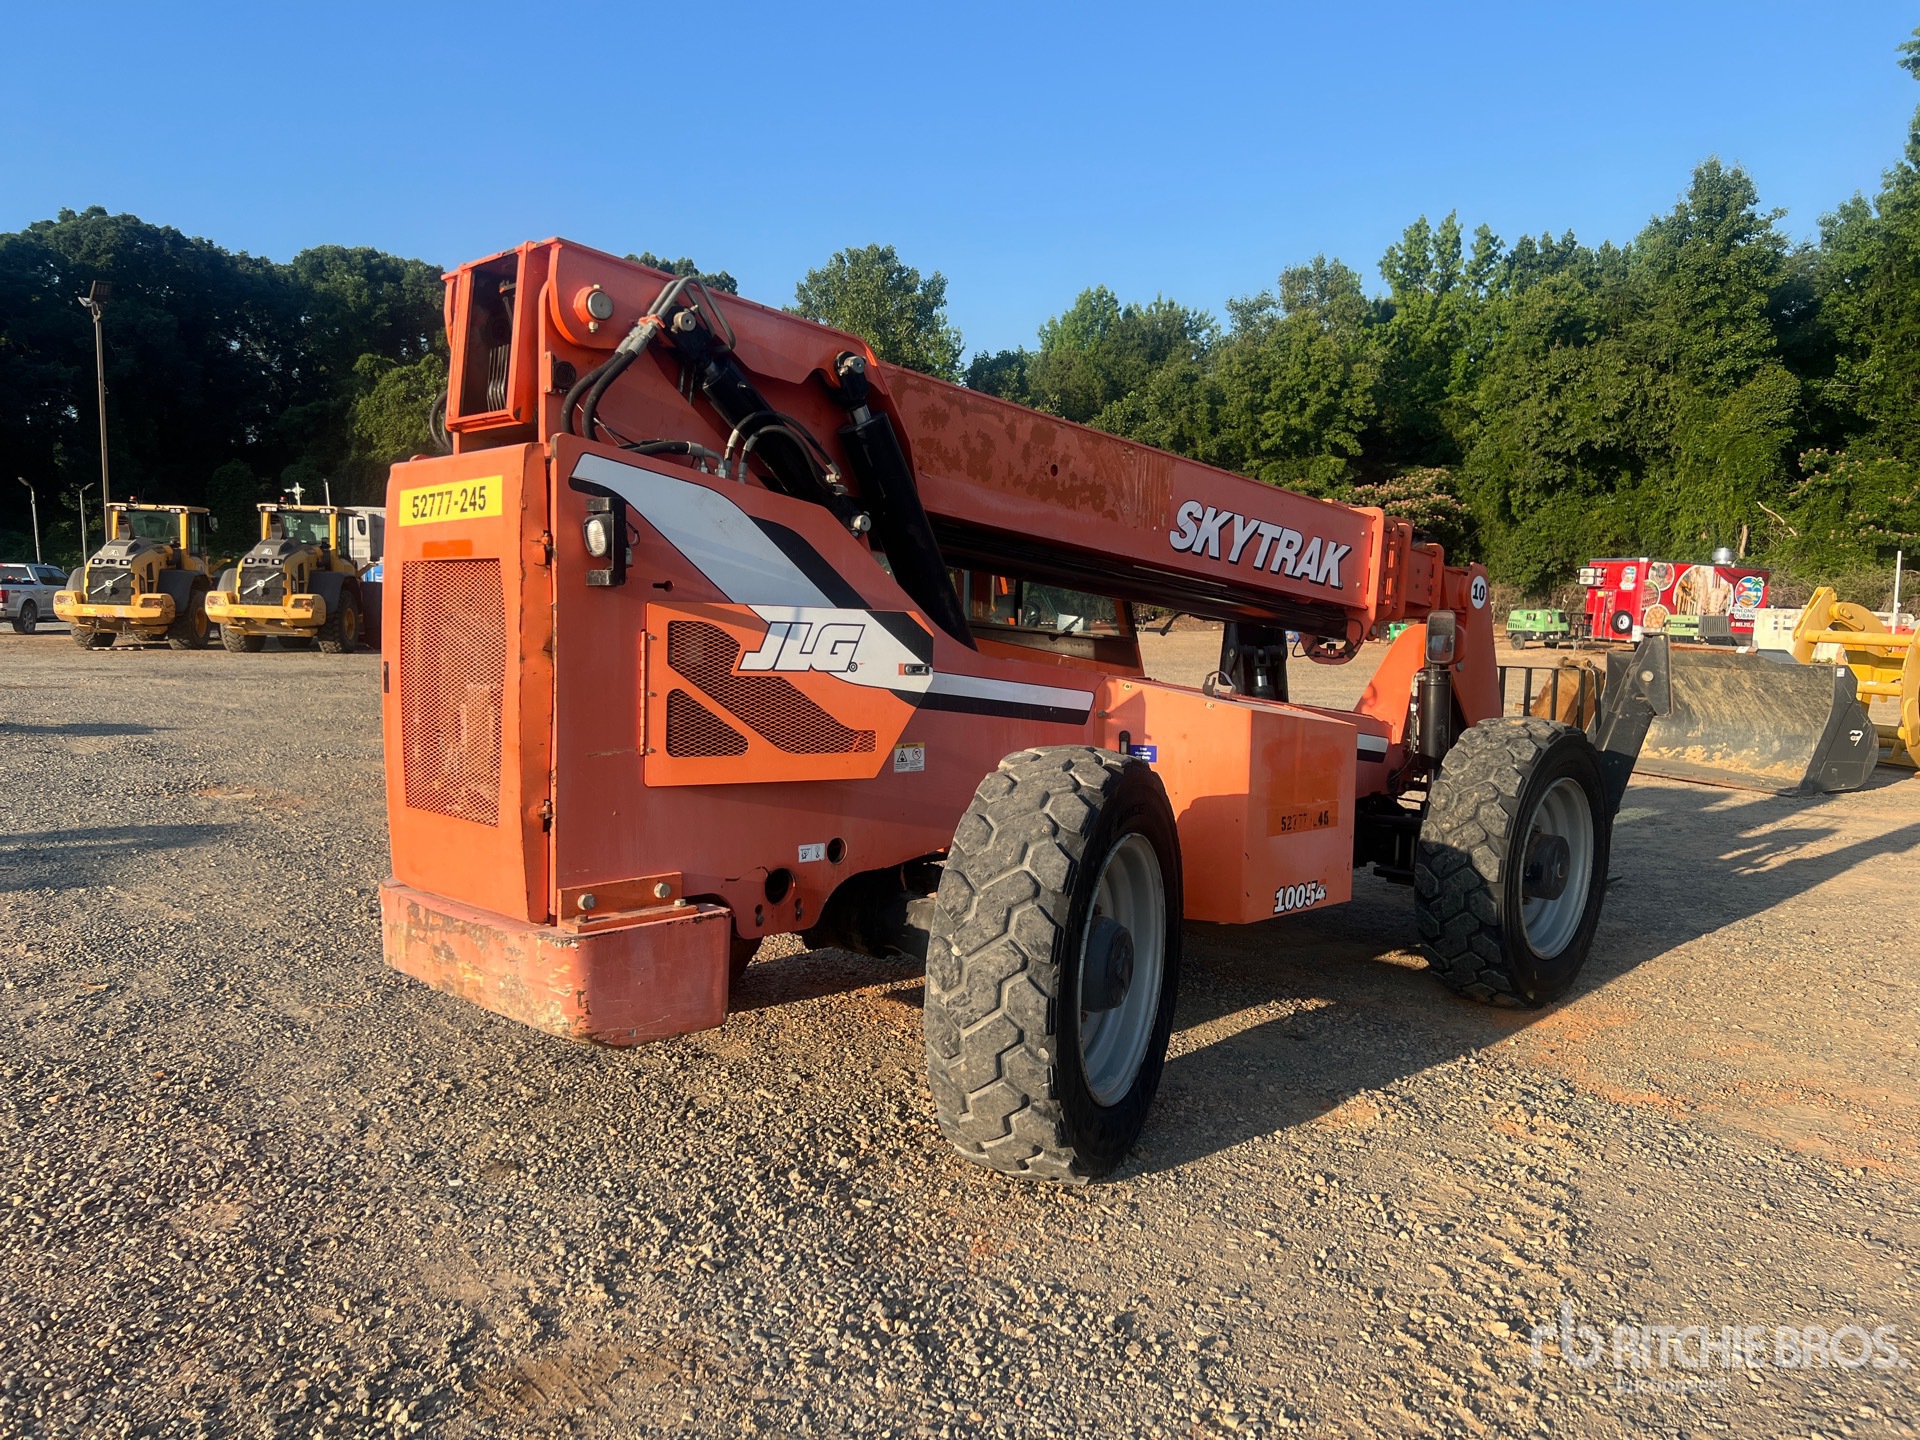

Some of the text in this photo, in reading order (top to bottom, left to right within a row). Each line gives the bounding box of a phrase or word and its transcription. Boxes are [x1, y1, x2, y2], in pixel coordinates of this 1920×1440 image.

[412, 485, 486, 519] 52777-245
[1168, 499, 1351, 588] SKYTRAK
[1472, 583, 1486, 602] 10
[737, 621, 866, 672] JLG
[1273, 880, 1326, 914] 10054
